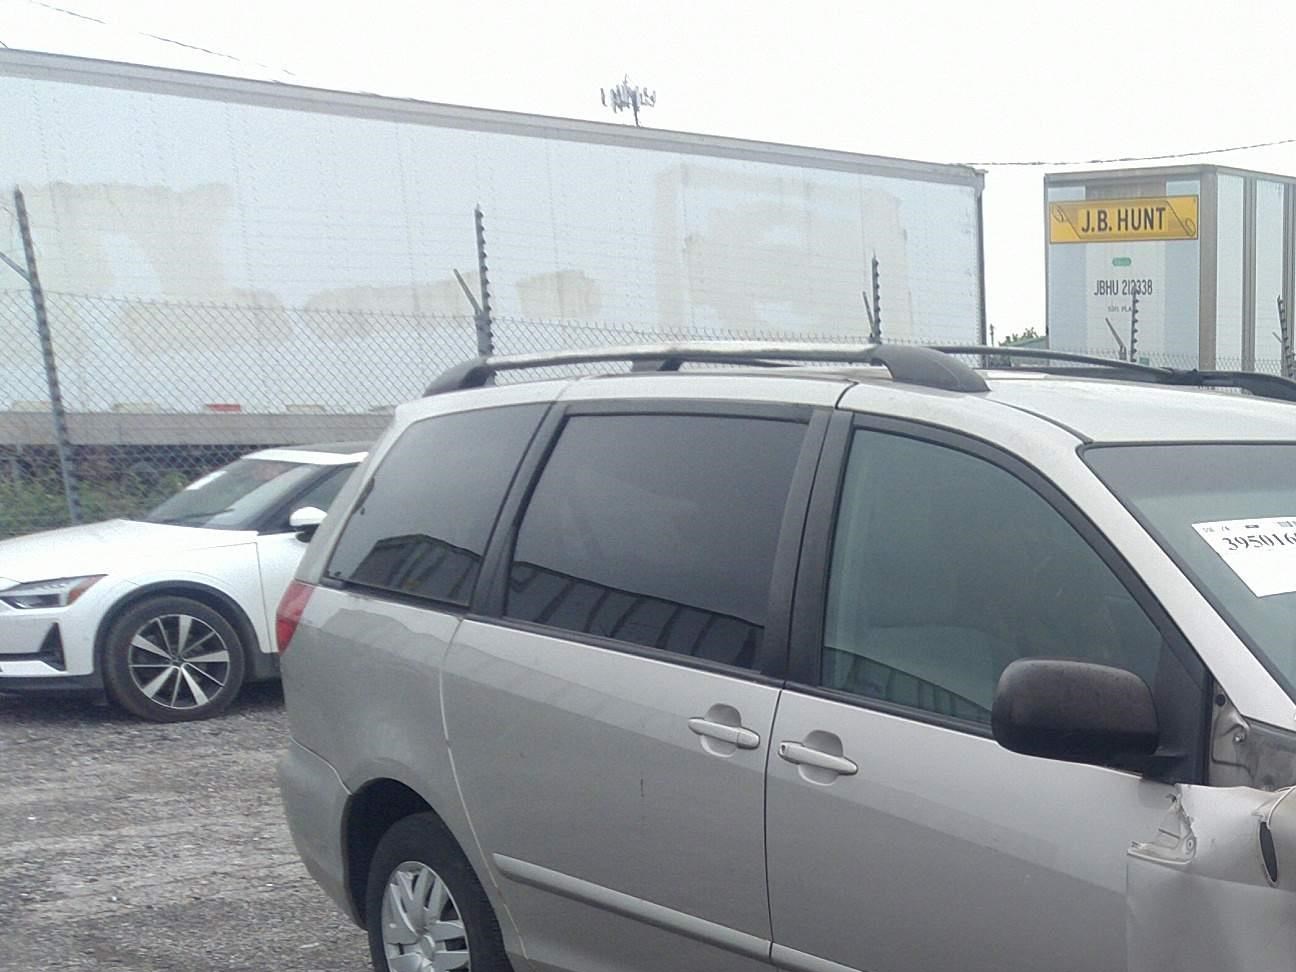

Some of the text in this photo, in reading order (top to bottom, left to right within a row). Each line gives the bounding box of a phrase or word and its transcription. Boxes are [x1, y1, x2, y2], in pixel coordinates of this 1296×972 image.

[1081, 207, 1166, 232] J.B. HUNT
[1094, 280, 1119, 296] JBHU
